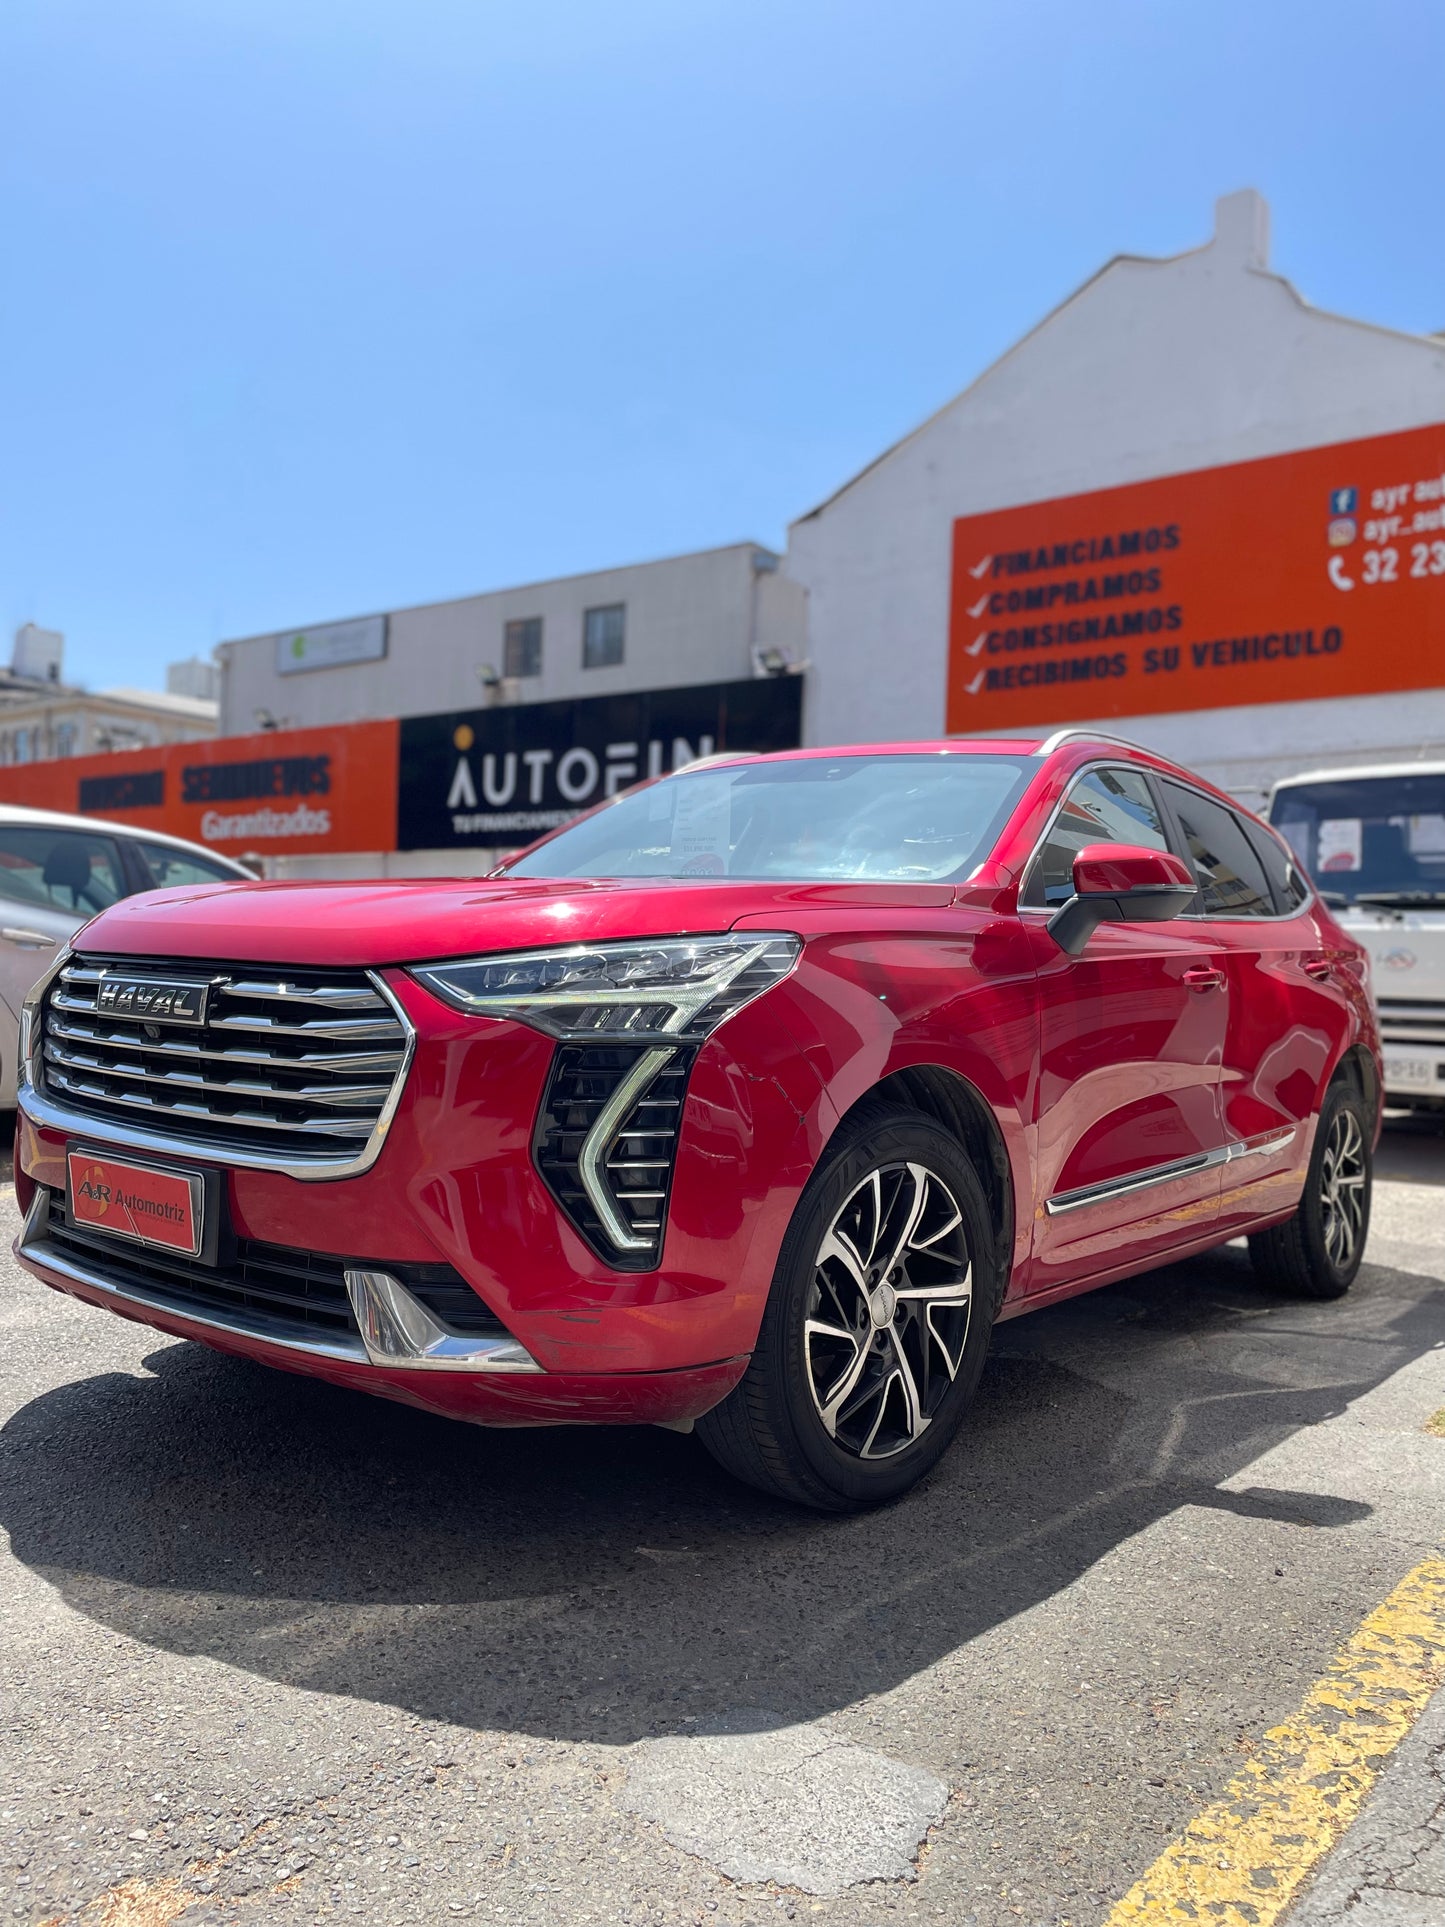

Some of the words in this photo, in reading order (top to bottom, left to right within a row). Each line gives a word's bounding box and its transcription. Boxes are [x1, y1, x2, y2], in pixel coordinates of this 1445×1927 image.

[1371, 484, 1411, 513] ayr
[992, 525, 1180, 577] FINANCIAMOS
[1362, 547, 1398, 584] 32
[989, 568, 1161, 615] COMPRAMOS
[987, 606, 1182, 653] CONSIGNAMOS
[985, 653, 1126, 692] RECIBIMOS
[1144, 647, 1179, 673] SU
[1192, 627, 1342, 668] VEHICULO
[201, 803, 331, 840] Garantizados
[101, 984, 194, 1015] HAVAL
[78, 1181, 111, 1202] A&R
[115, 1188, 185, 1223] Automotriz
